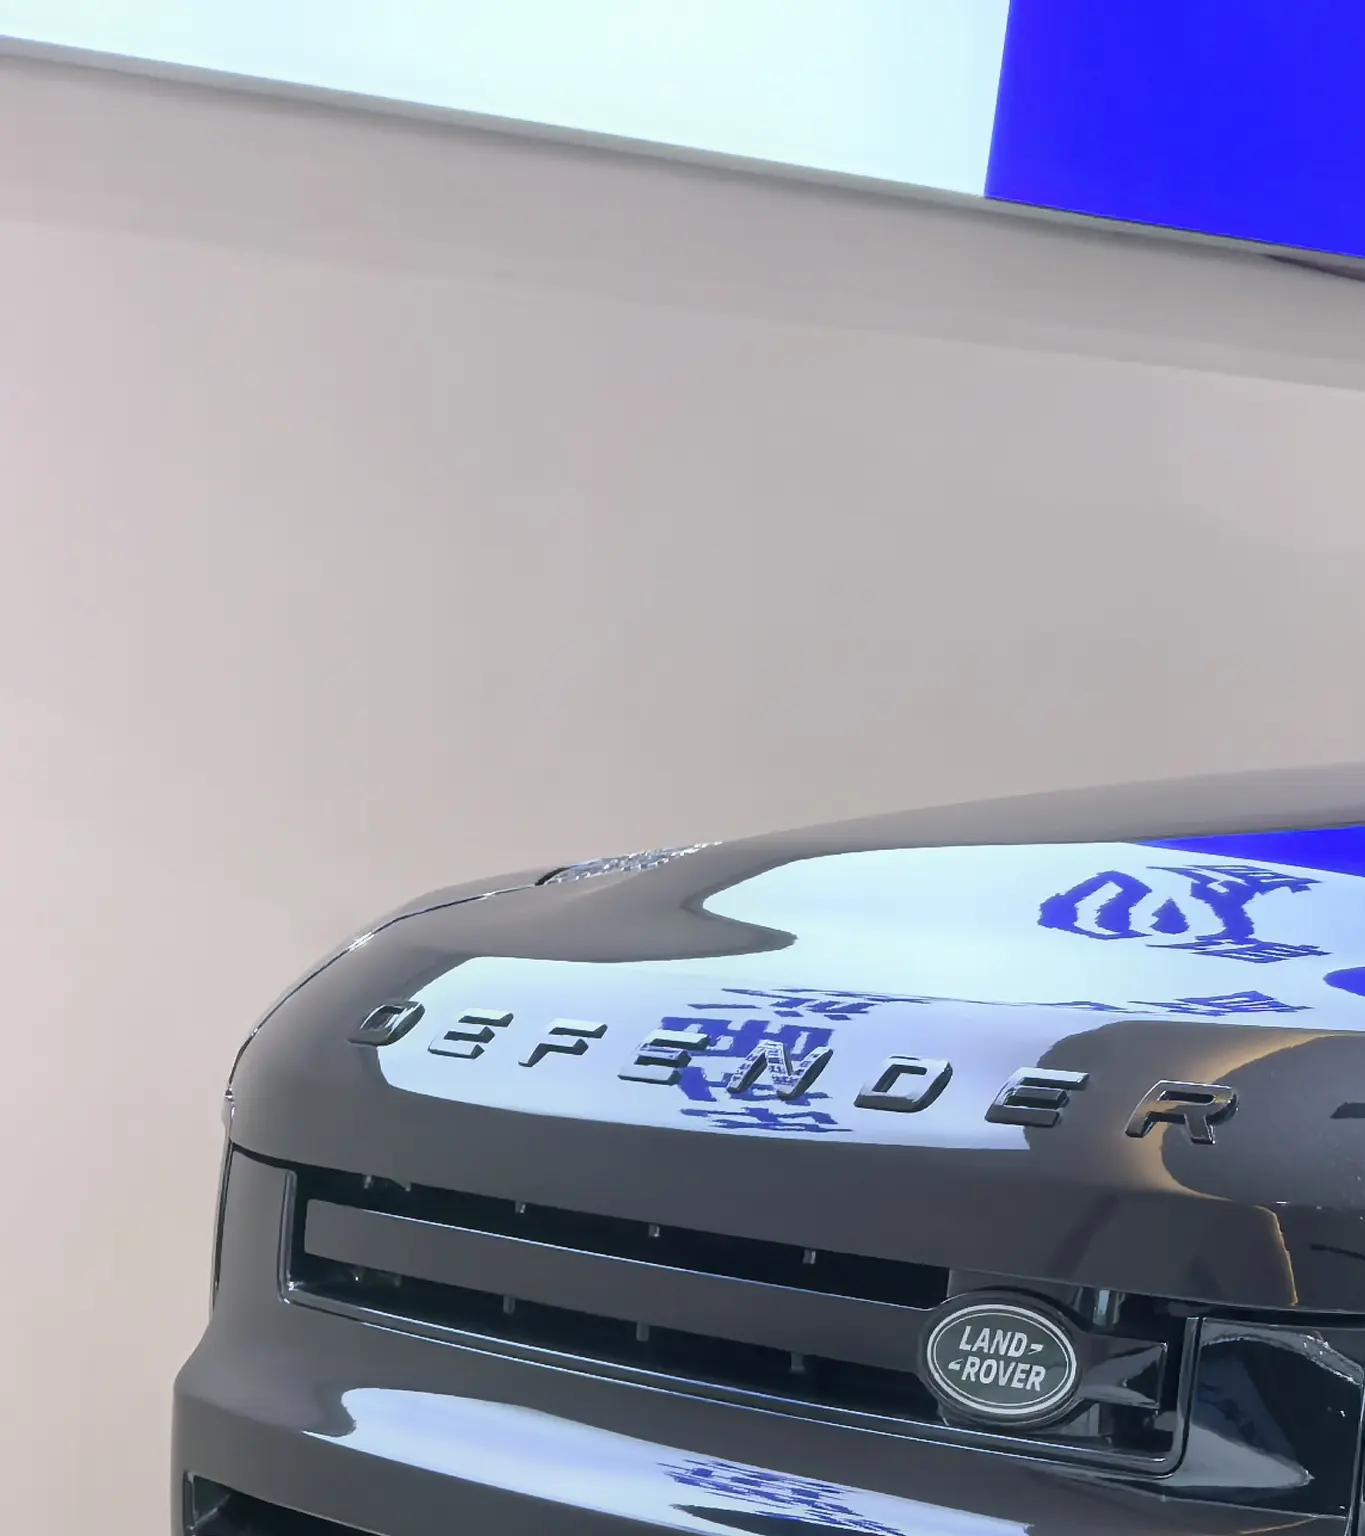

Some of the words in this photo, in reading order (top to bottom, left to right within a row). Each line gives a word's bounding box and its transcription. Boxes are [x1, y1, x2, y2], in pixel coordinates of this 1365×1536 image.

[347, 998, 1239, 1145] DEFENDER
[958, 1325, 1028, 1359] LAND
[960, 1355, 1047, 1392] ROVER
